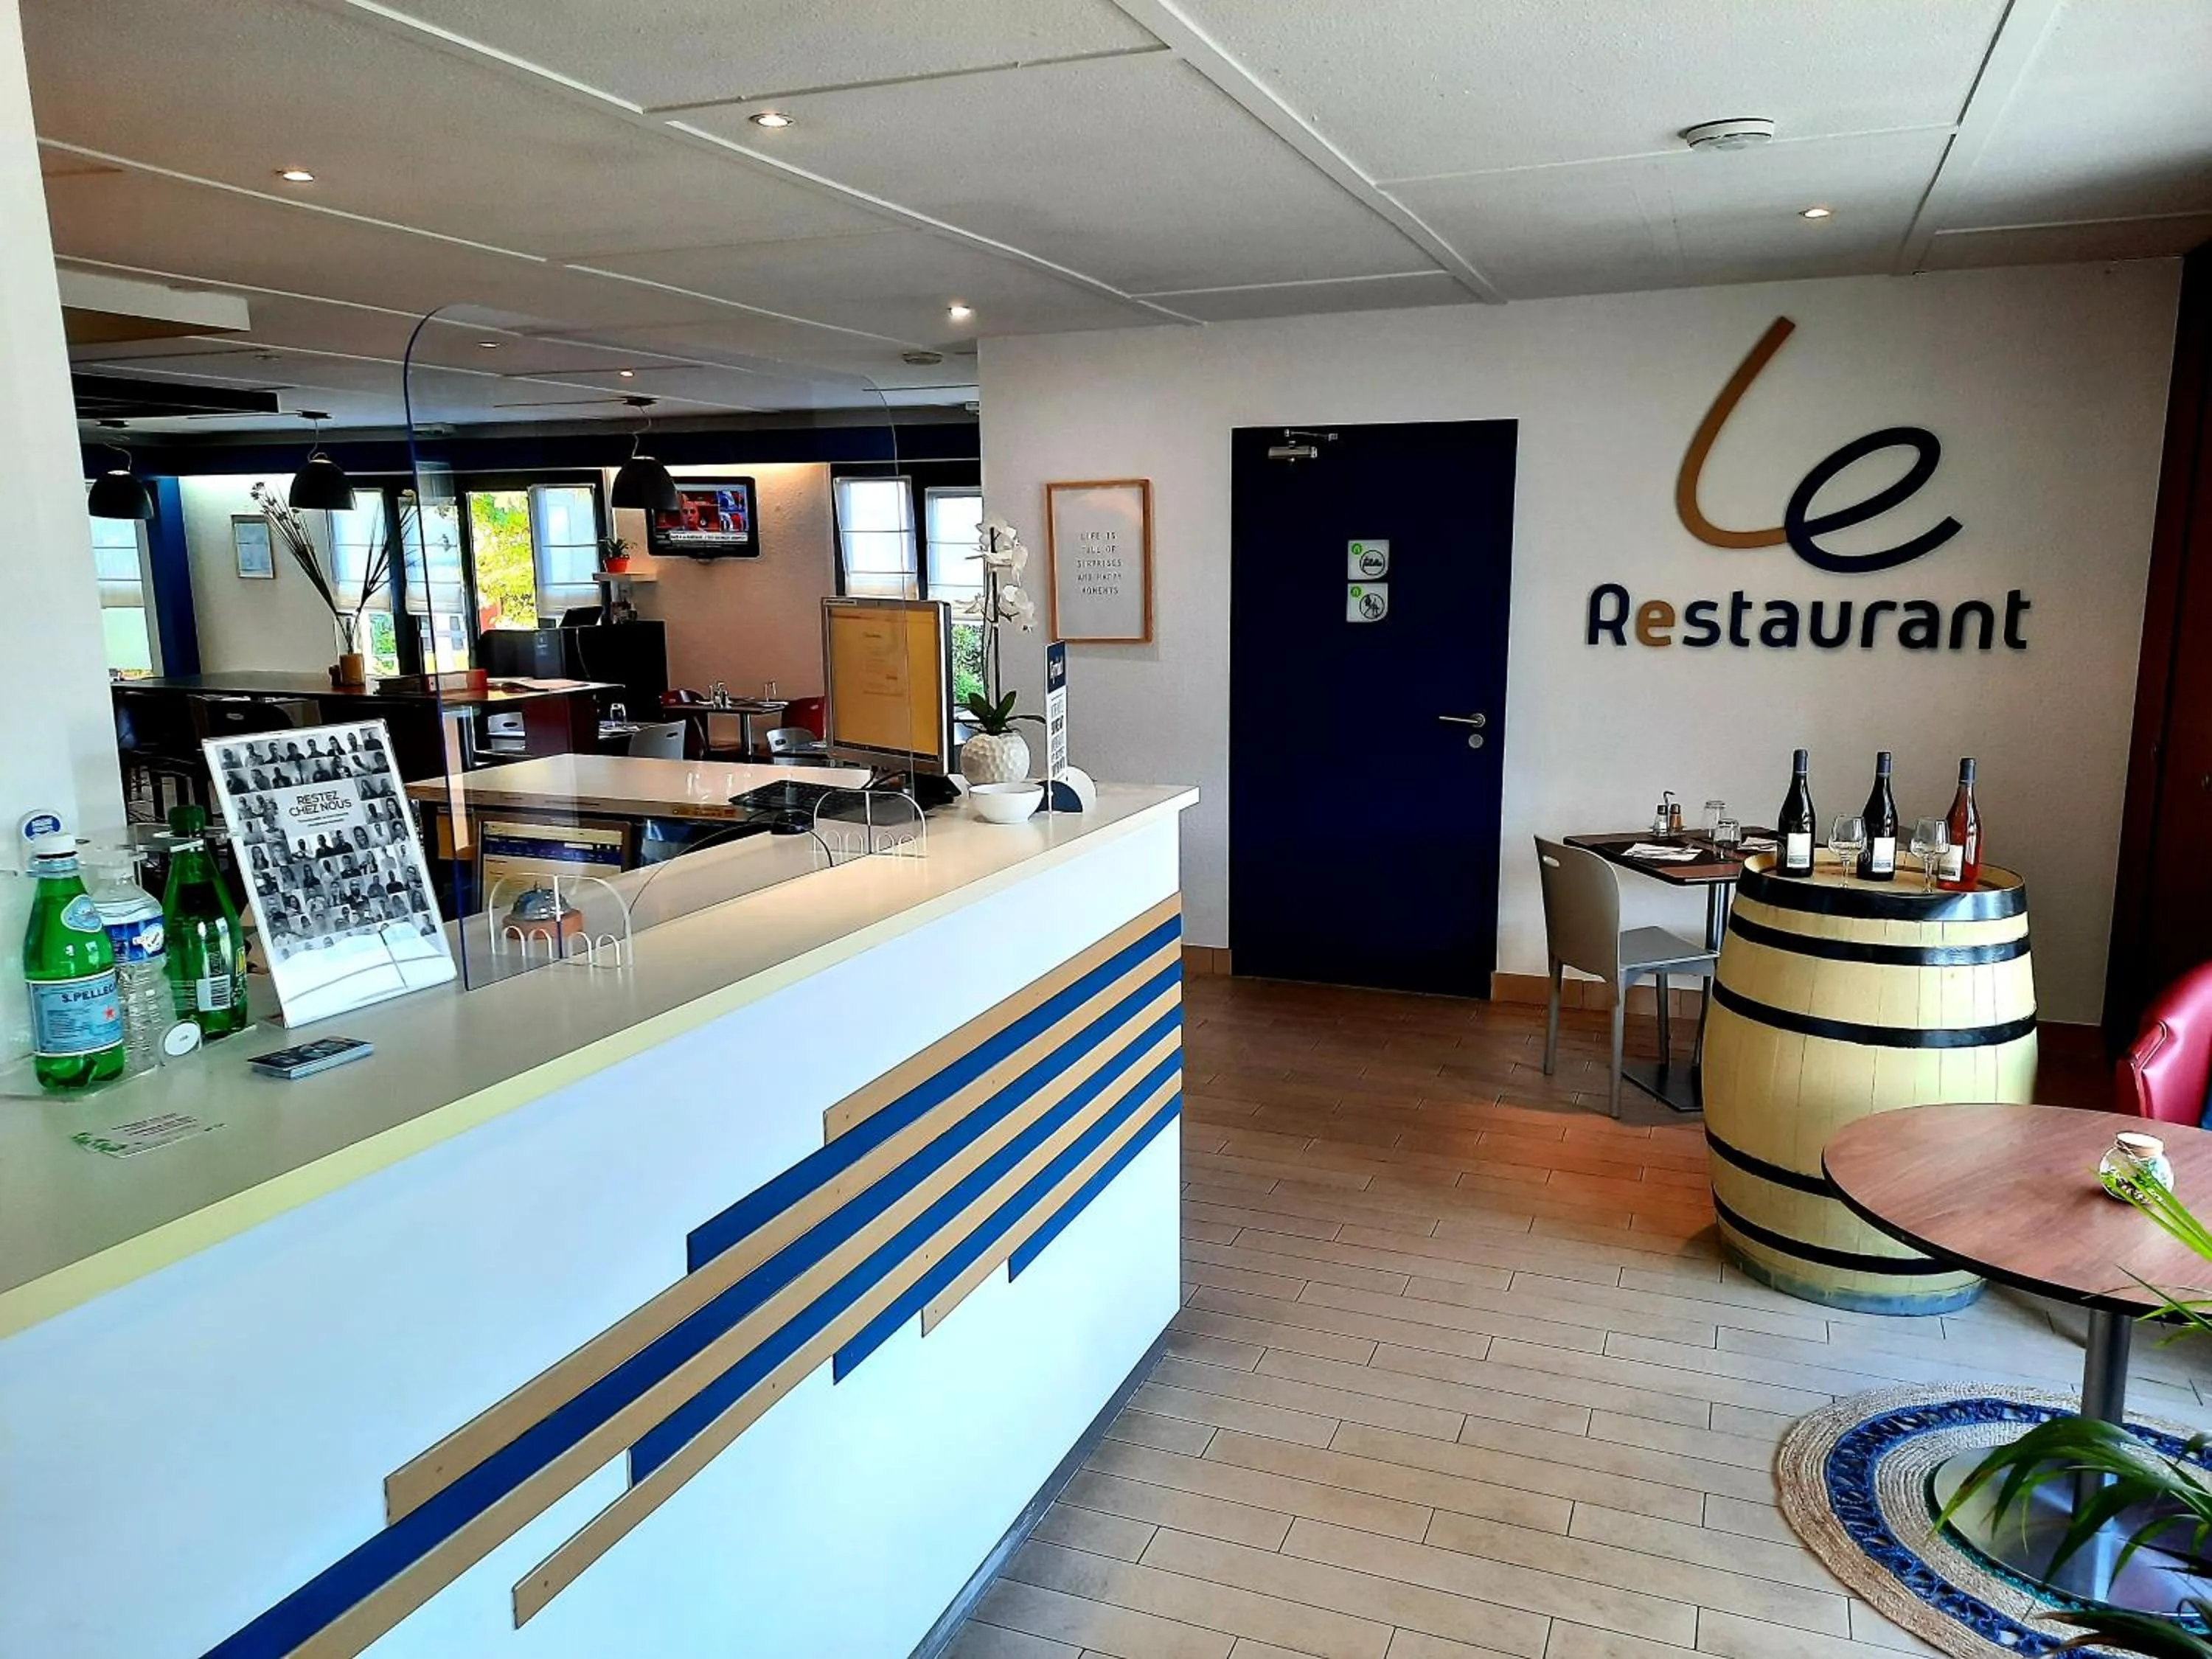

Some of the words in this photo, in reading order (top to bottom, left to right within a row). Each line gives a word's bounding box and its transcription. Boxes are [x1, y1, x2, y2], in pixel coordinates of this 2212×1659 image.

[1079, 532, 1101, 540] LIFE
[1106, 532, 1116, 540] IS
[1587, 584, 2031, 650] Restaurant
[296, 790, 339, 805] RESTEZ
[288, 803, 319, 816] CHEZ
[319, 799, 352, 811] NOUS
